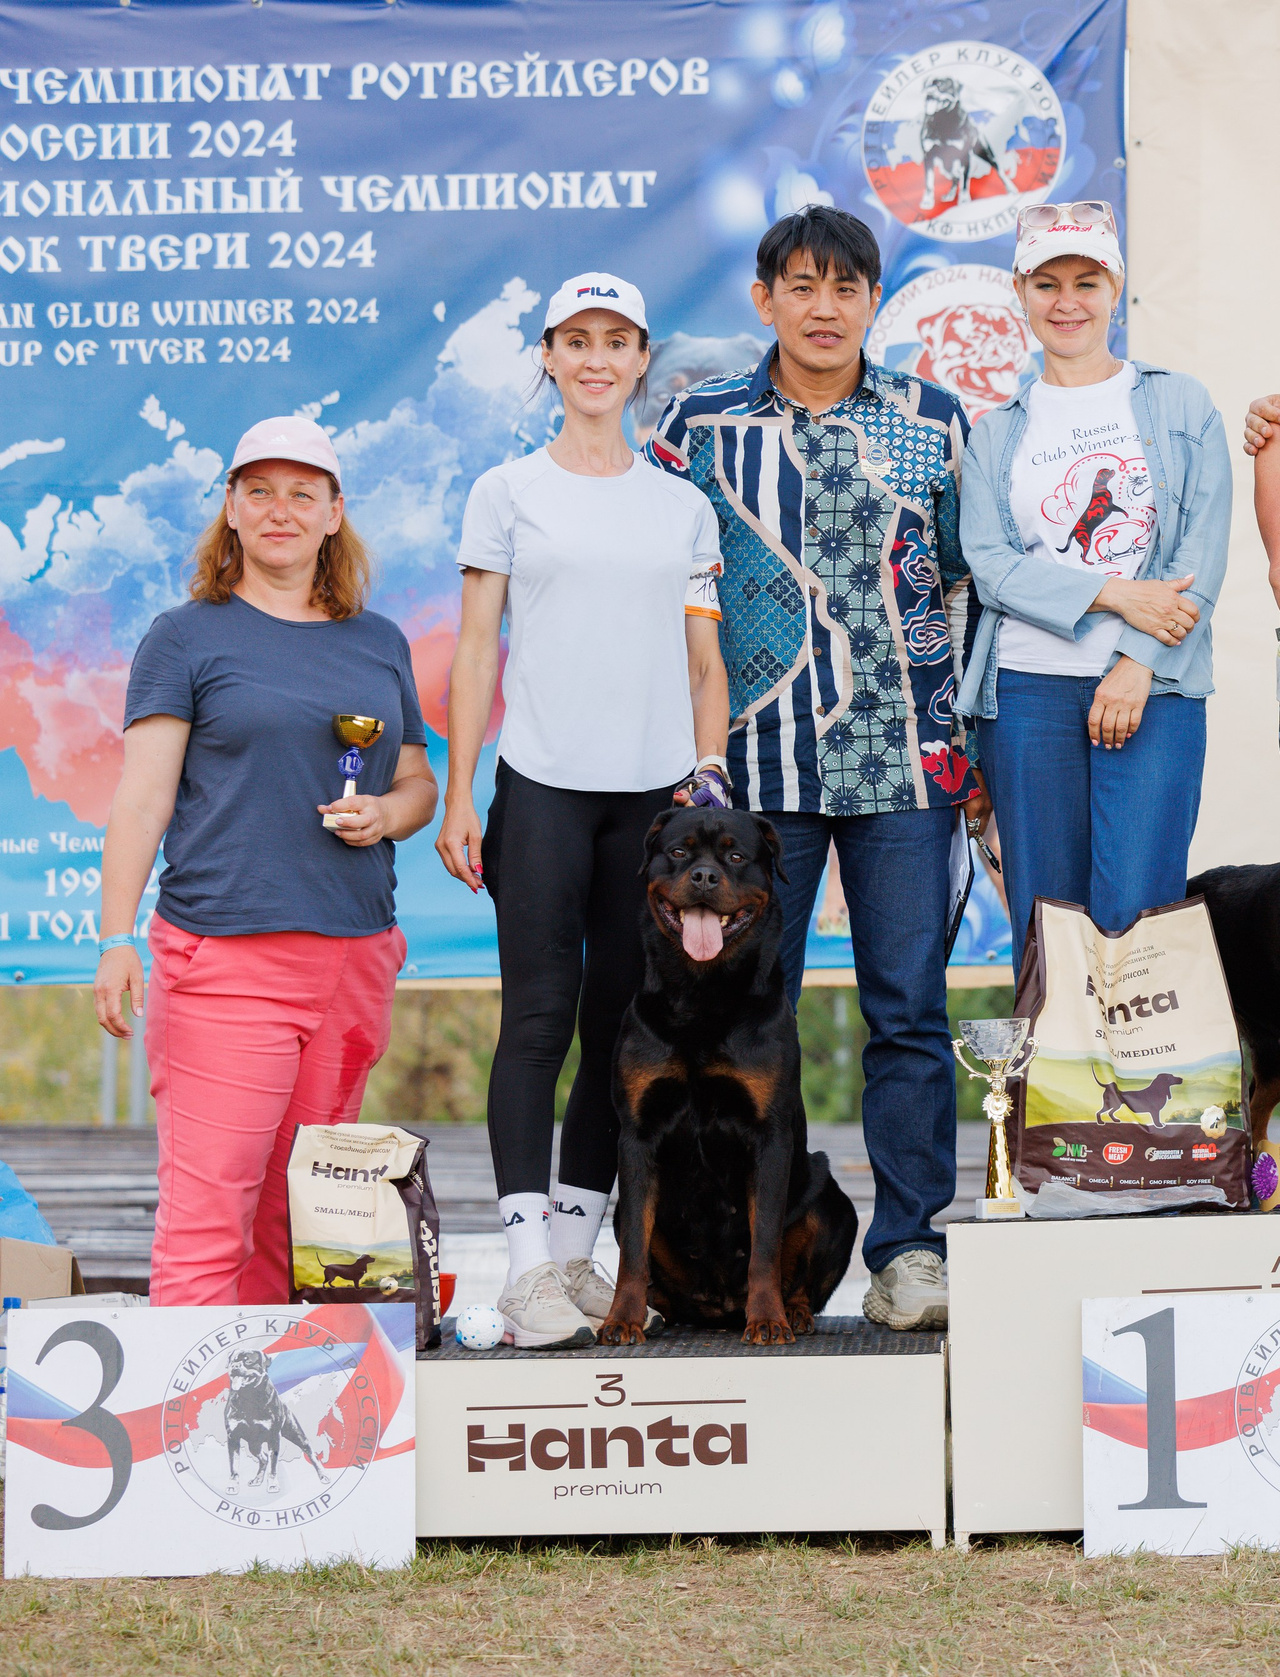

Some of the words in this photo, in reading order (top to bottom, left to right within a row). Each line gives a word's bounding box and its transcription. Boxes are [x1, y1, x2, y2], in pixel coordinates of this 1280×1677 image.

[0, 63, 332, 105] ЧЕМПИОНАТ
[348, 51, 710, 100] РОТВЕЙЛЕРОВ
[956, 47, 1027, 79] КЛУБ
[187, 119, 298, 158] 2024
[320, 170, 658, 213] ЧЕМПИОНАТ
[77, 232, 251, 272] ТВЕРИ
[267, 231, 378, 270] 2024
[576, 286, 620, 299] FILA
[922, 266, 968, 291] 2024
[46, 301, 140, 329] CLUB
[151, 298, 296, 327] WINNER
[306, 297, 381, 325] 2024
[53, 339, 100, 367] OF
[110, 337, 208, 365] TVER
[218, 335, 292, 364] 2024
[1071, 421, 1120, 440] Russia
[1030, 446, 1068, 467] Club
[1108, 1146, 1128, 1154] FRESH
[1108, 1153, 1124, 1161] MEAT
[553, 1200, 587, 1217] ILA
[165, 1323, 249, 1475] РОТВЕЙЛЕР
[264, 1318, 337, 1352] КЛУБ
[341, 1357, 377, 1471] РОССИИ
[594, 1373, 627, 1407] 3
[30, 1319, 134, 1531] 3
[1110, 1307, 1208, 1511] 1
[467, 1415, 748, 1473] Hanta
[553, 1480, 662, 1500] premium
[215, 1492, 333, 1526] РКФ-НКПР
